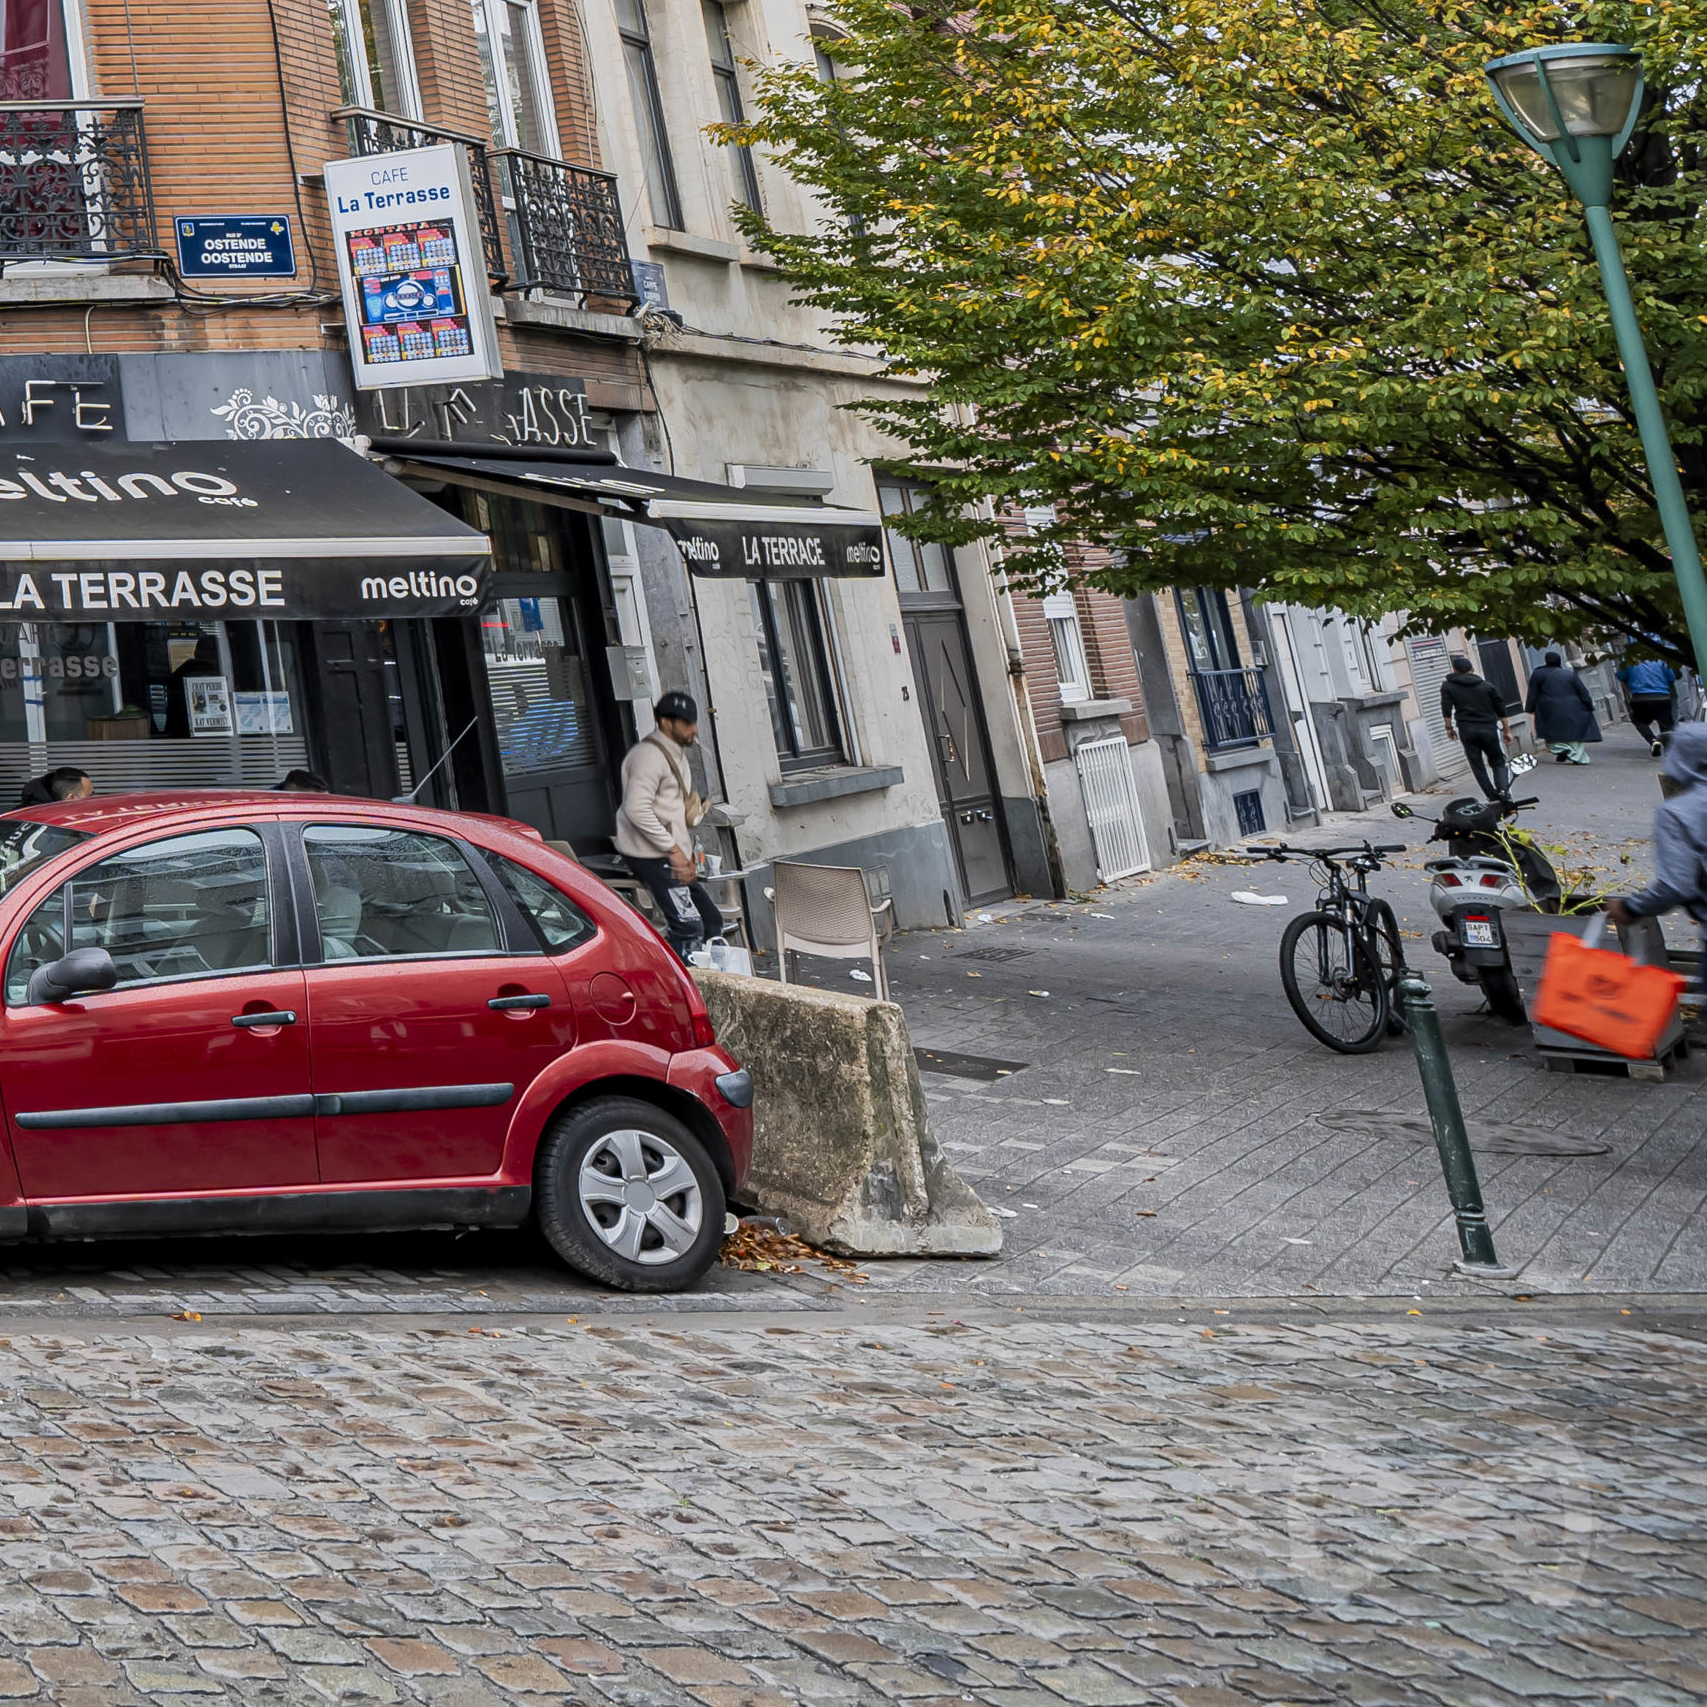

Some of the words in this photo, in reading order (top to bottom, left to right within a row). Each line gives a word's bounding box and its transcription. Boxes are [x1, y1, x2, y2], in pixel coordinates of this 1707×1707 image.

[371, 167, 409, 186] CAFE
[337, 195, 360, 214] La
[364, 186, 451, 210] Terrasse
[350, 221, 430, 238] MONTANA
[204, 238, 267, 251] OSTENDE
[201, 252, 273, 265] OOSTENDE
[197, 495, 259, 508] café
[742, 536, 761, 565] LA
[761, 536, 826, 566] TERRACE
[52, 569, 286, 609] TERRASSE
[361, 571, 478, 599] meltino
